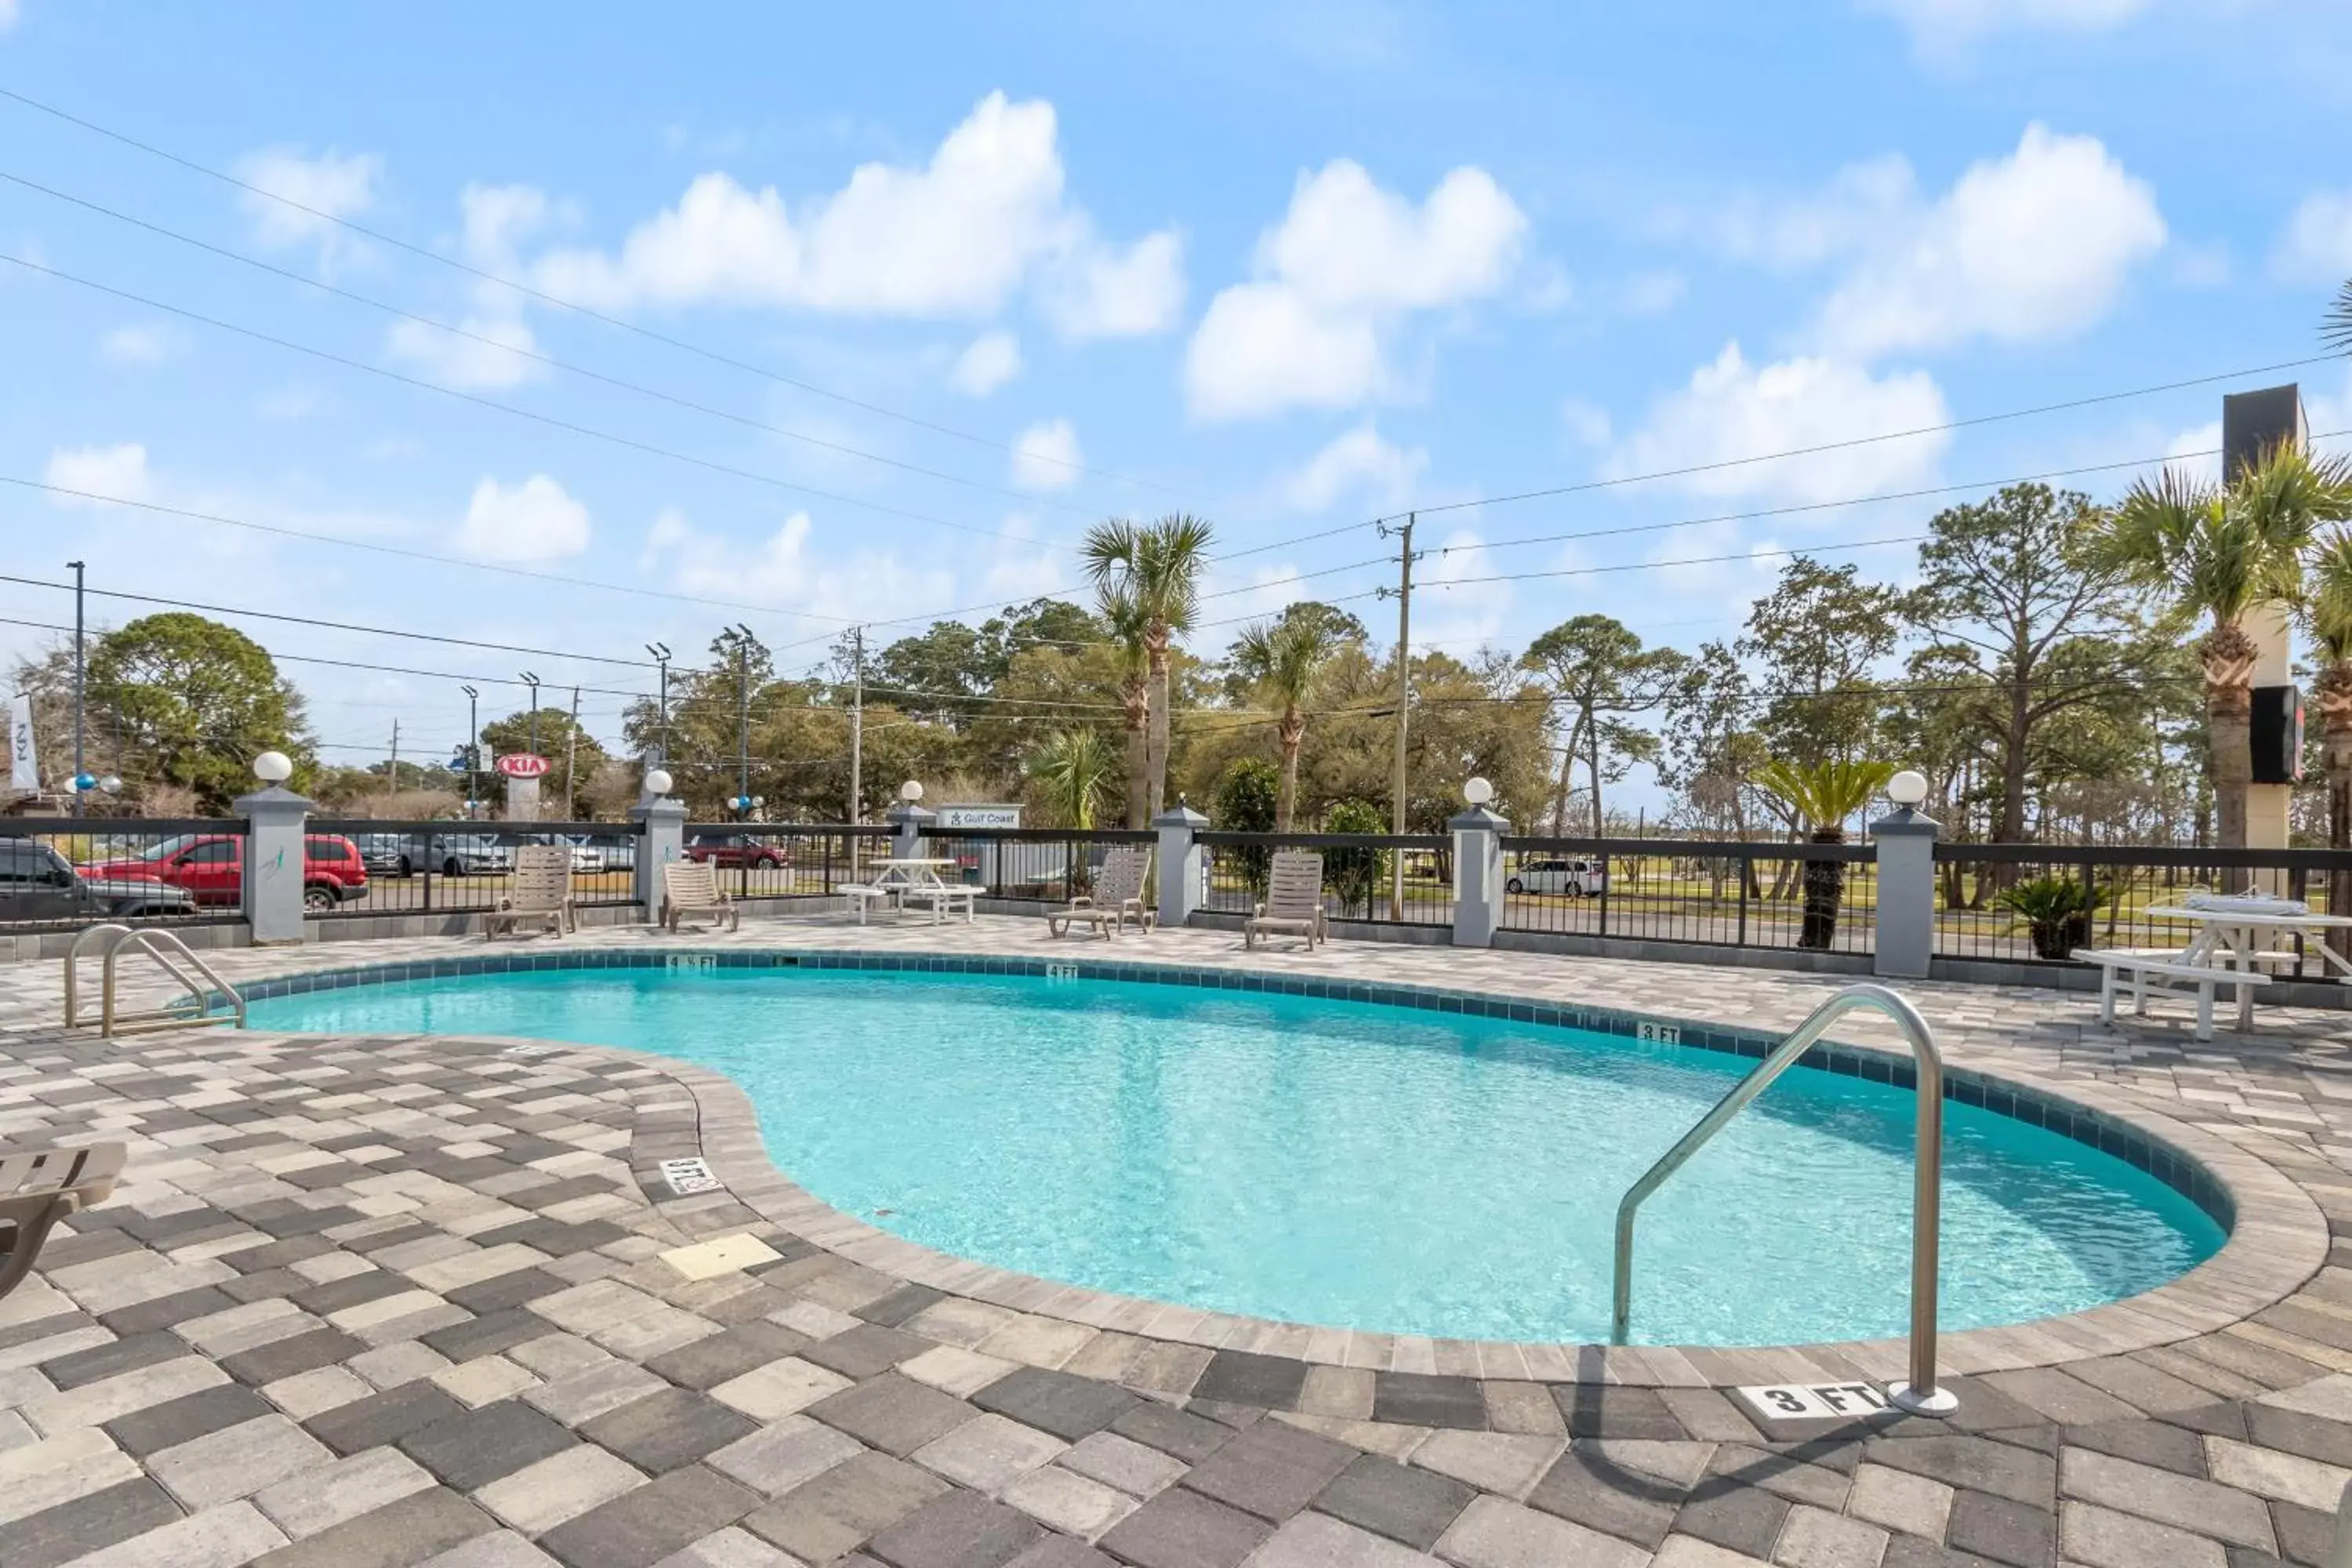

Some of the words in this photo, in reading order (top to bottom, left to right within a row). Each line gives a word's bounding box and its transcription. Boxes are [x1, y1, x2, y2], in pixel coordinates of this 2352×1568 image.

[507, 758, 542, 772] KIA
[964, 813, 985, 822] Gulf
[988, 813, 1014, 822] Coast
[700, 956, 713, 969] FT
[1051, 965, 1058, 978] 4
[1063, 966, 1076, 979] FT
[1644, 1025, 1653, 1040] 3
[1660, 1026, 1678, 1043] FT
[1765, 1390, 1807, 1412] 3
[1813, 1385, 1884, 1410] FT
